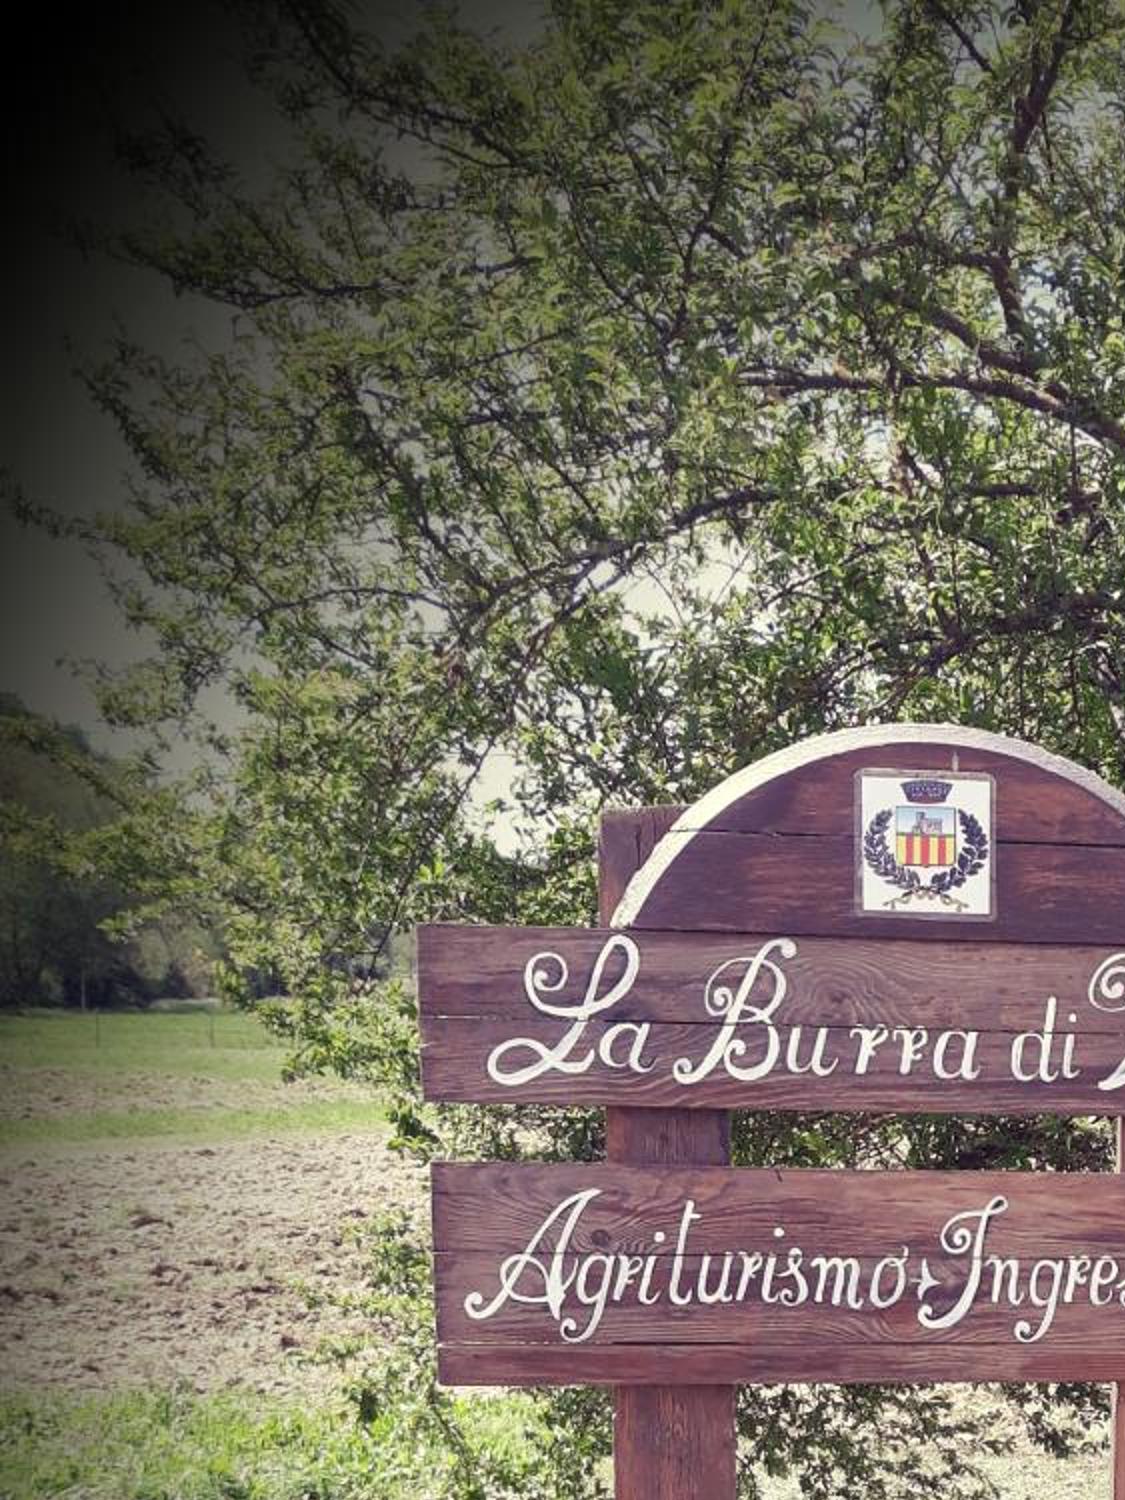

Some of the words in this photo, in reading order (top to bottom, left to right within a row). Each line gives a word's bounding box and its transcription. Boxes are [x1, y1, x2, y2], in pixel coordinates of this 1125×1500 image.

[486, 933, 659, 1087] La
[672, 936, 981, 1086] Burra
[1010, 996, 1081, 1084] di
[463, 1187, 909, 1344] Agriturismo
